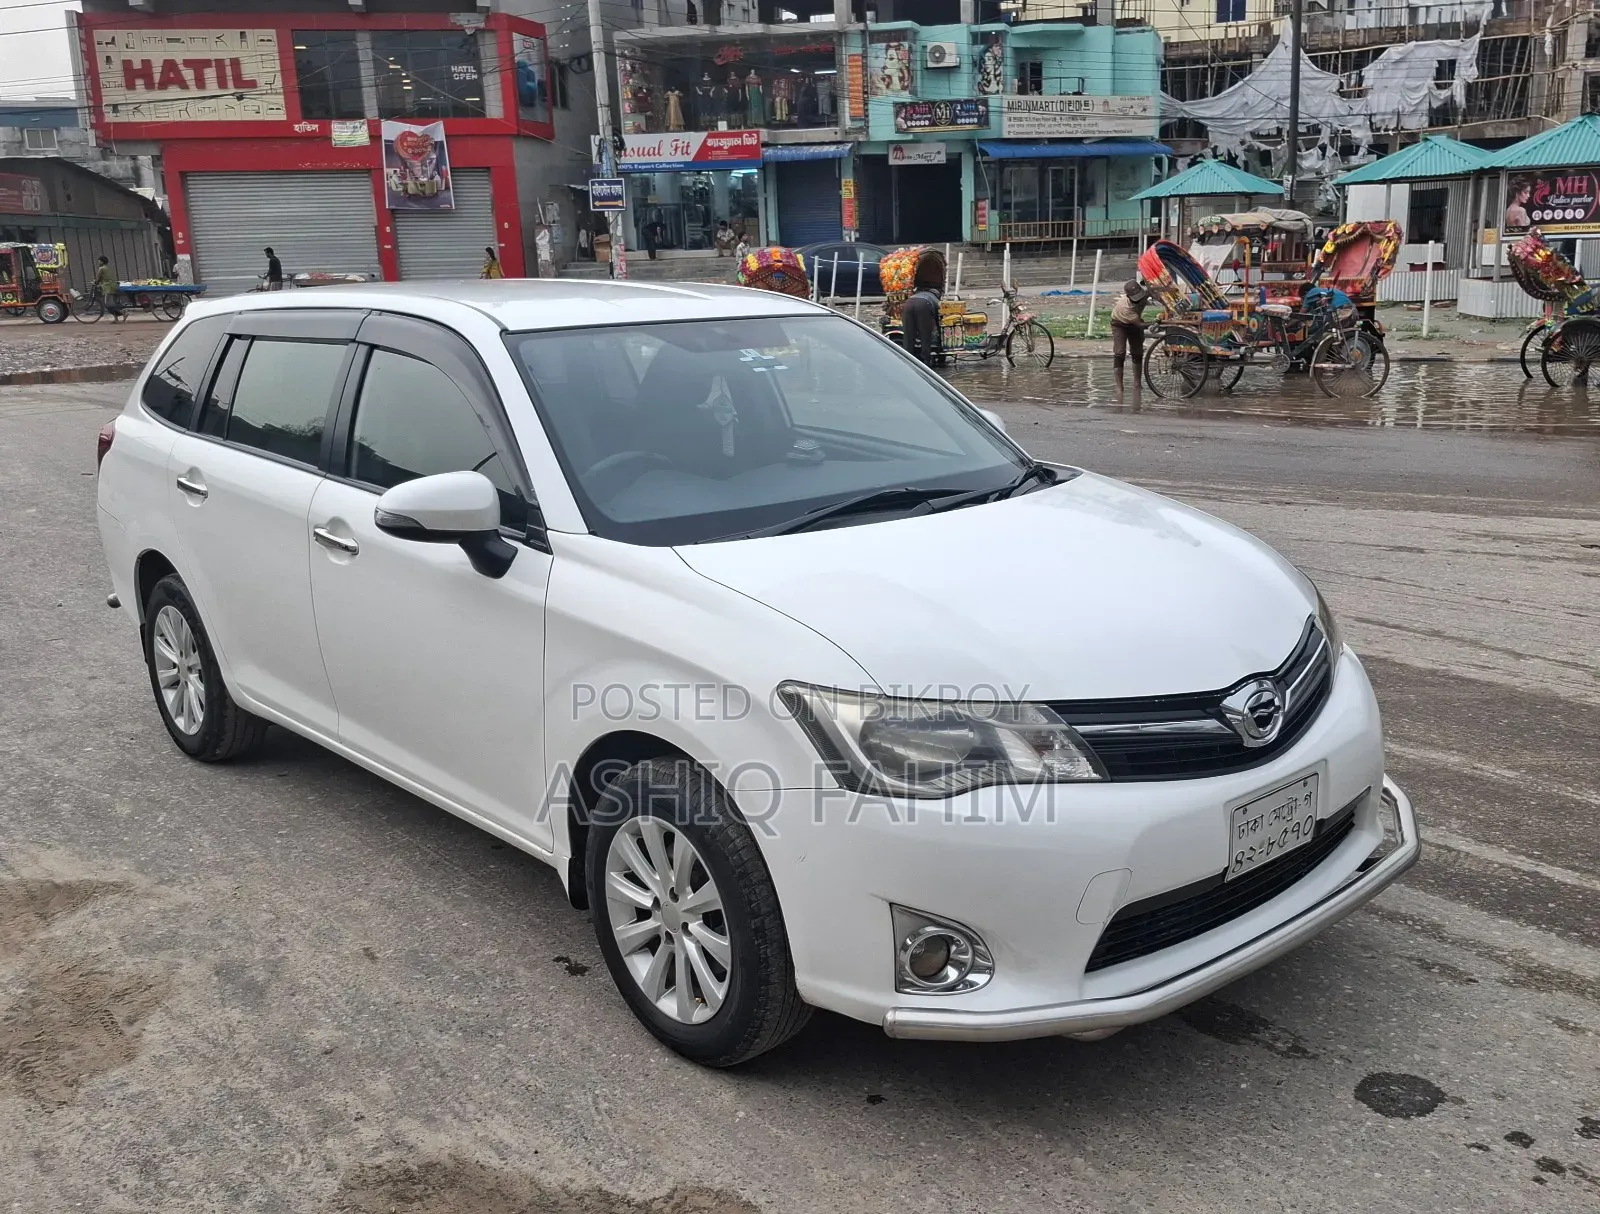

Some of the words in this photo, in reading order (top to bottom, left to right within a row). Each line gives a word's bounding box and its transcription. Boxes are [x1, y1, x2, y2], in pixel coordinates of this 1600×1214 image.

[121, 58, 258, 91] HATIL
[450, 65, 477, 73] HATIL
[293, 121, 319, 133] হাতিল
[619, 139, 664, 158] asual
[669, 138, 692, 157] Fit
[742, 133, 758, 146] ফিট
[1555, 175, 1589, 195] MH
[1547, 194, 1570, 207] Ladies
[1570, 194, 1594, 205] parlor
[1237, 813, 1265, 840] ঢাকা
[1231, 814, 1314, 874] ৪২-৮৫৭০
